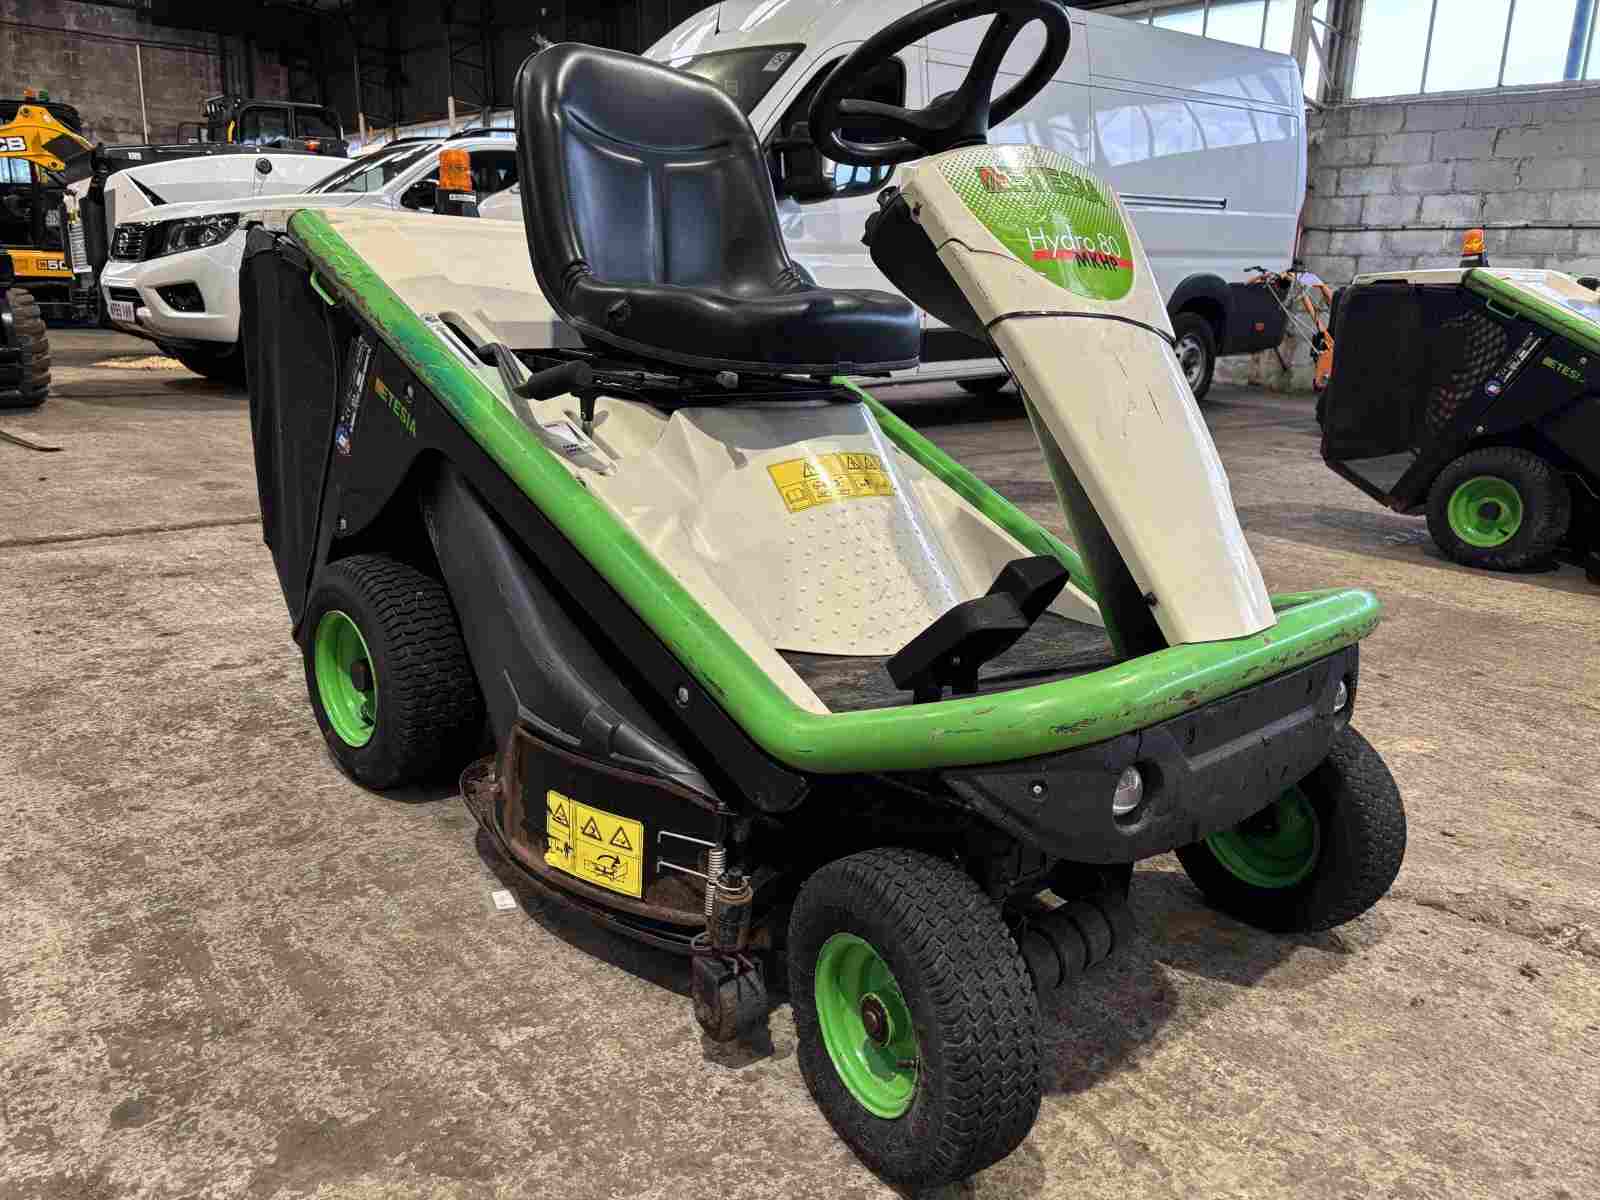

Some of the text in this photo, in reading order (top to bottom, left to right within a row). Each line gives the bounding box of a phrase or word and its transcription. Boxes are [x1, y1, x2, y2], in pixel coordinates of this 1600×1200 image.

[1025, 224, 1121, 258] Hydro 80
[1073, 249, 1119, 272] MKHP
